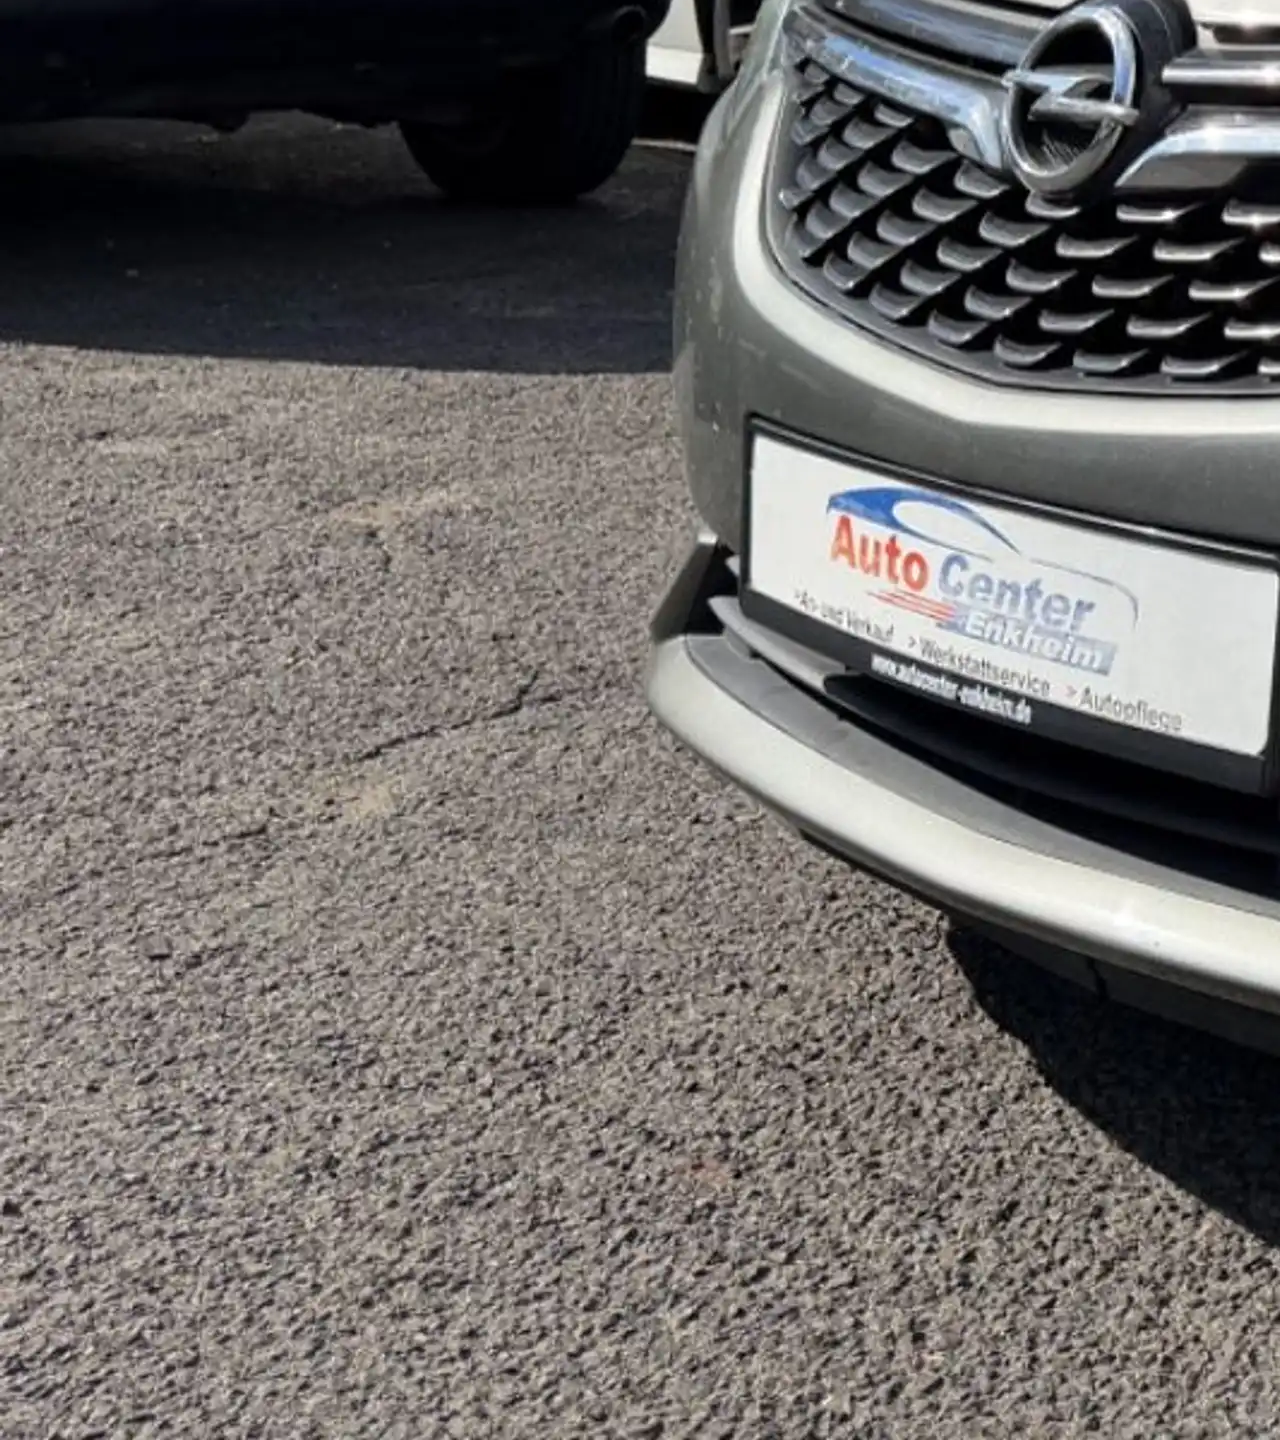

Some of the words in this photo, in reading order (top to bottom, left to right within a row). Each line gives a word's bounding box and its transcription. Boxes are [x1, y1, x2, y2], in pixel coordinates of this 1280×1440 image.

[830, 515, 930, 593] Auto
[938, 553, 1097, 633] Center
[919, 636, 1052, 695] Werkstattservice
[1078, 684, 1184, 732] Autopflege
[965, 611, 1107, 673] Enkheim
